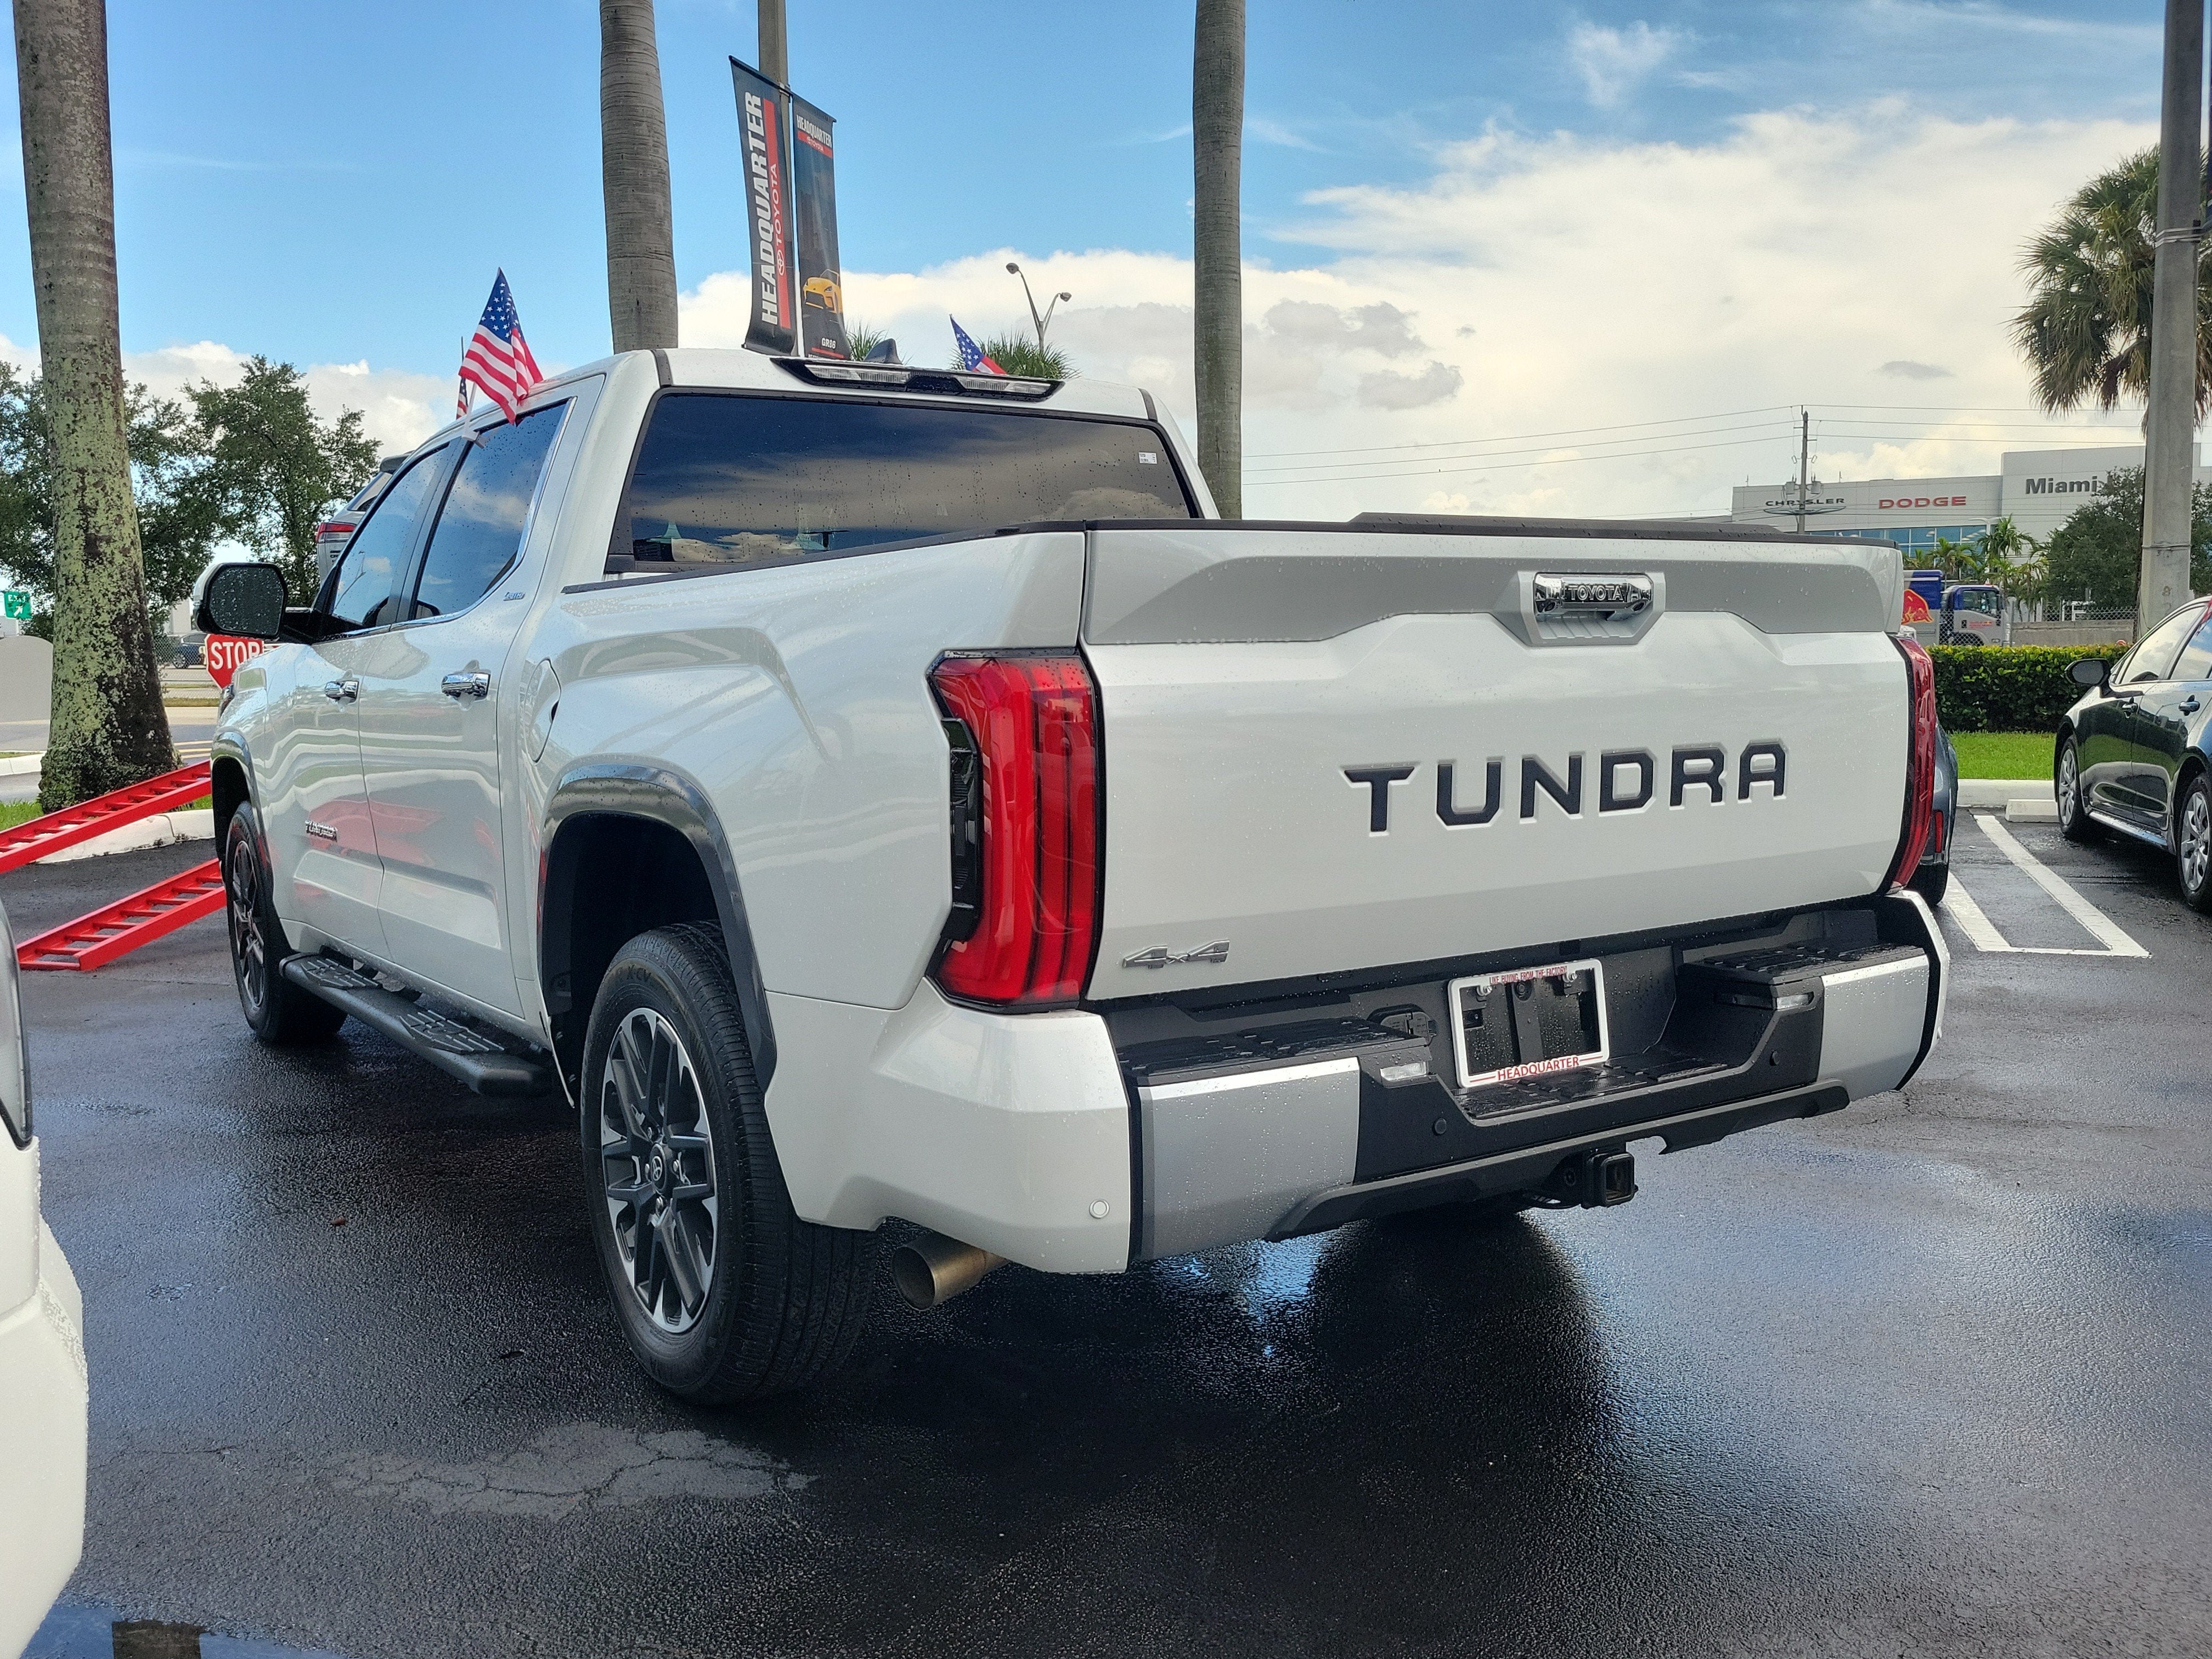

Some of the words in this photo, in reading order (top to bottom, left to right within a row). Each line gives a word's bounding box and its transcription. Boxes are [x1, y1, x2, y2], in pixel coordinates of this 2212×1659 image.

[796, 114, 832, 149] HEADQUARTER
[745, 91, 778, 325] HEADQUARTER
[770, 163, 782, 247] TOYOTA
[821, 337, 836, 349] GR86
[2025, 476, 2097, 494] Miami
[1878, 496, 1966, 509] DODGE
[1568, 584, 1623, 601] TOYOTA
[211, 641, 260, 669] STOP
[1340, 740, 1788, 836] TUNDRA
[1489, 976, 1499, 985] LIKE
[1501, 973, 1519, 984] BUYING
[1520, 970, 1533, 981] FROM
[1536, 969, 1544, 979] THE
[1497, 1057, 1579, 1081] HEADQUARTER
